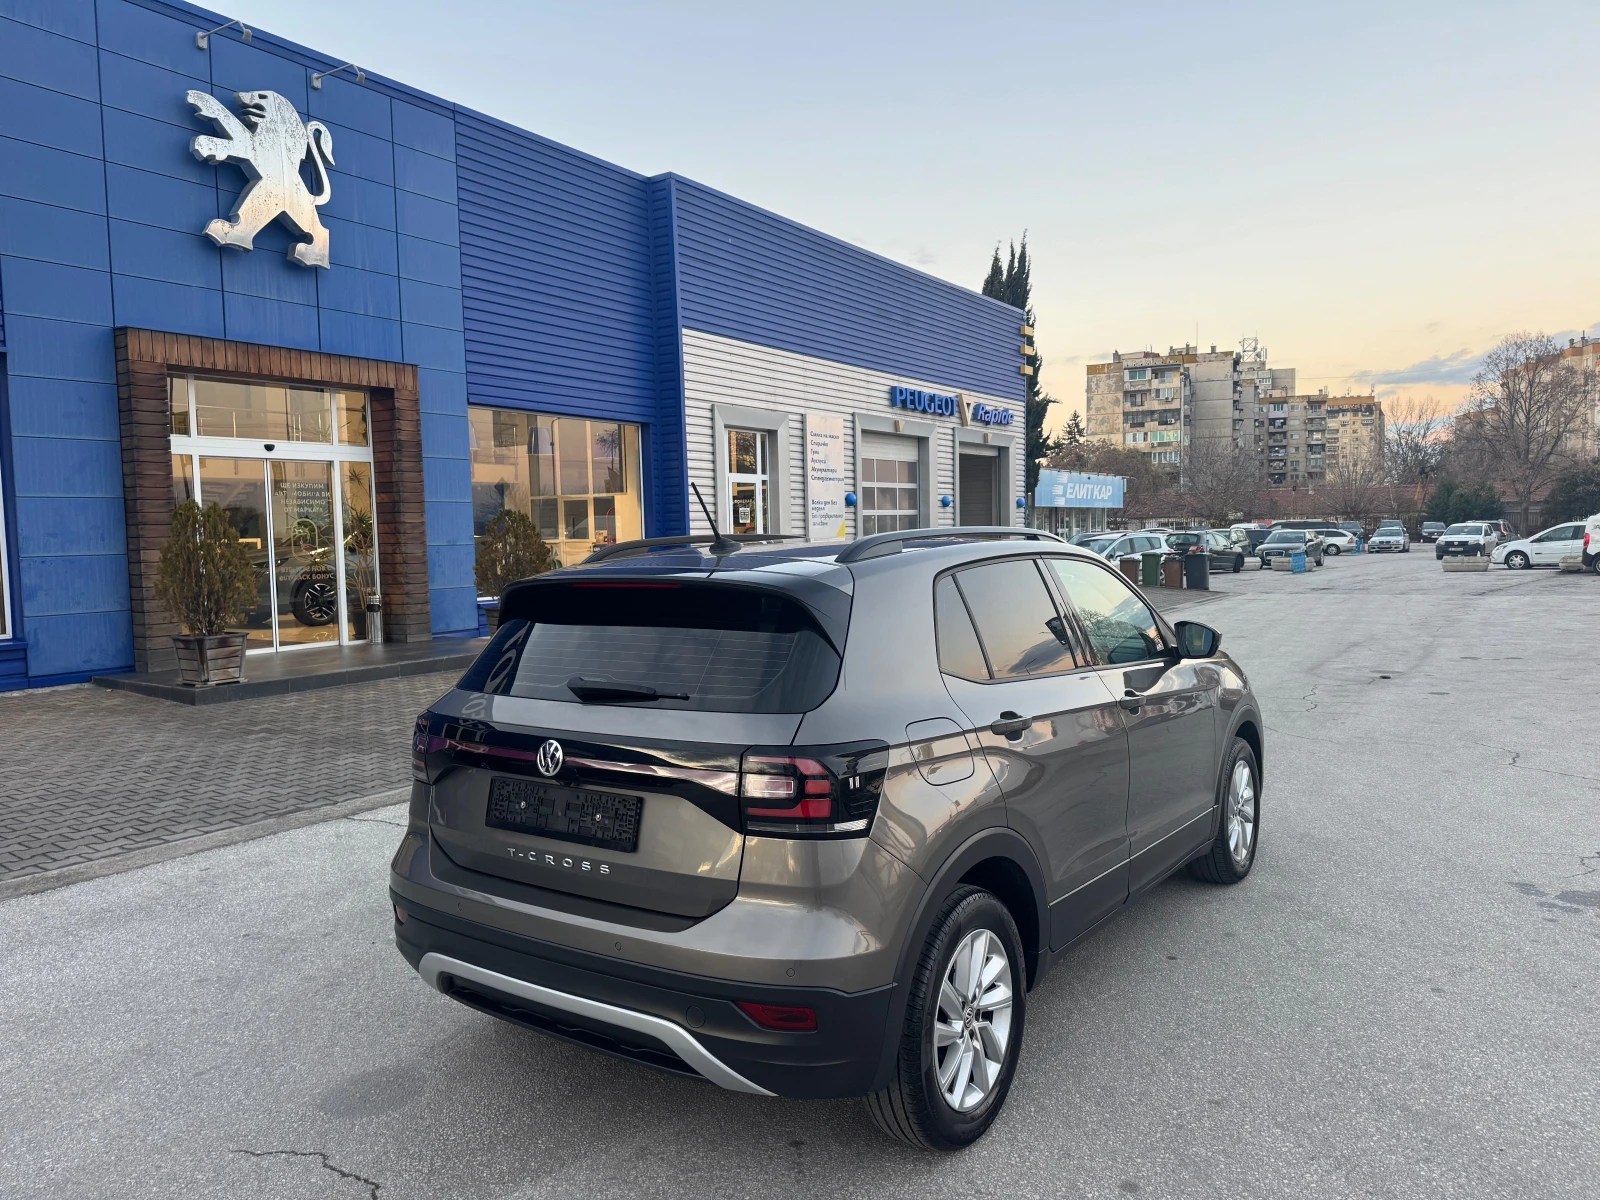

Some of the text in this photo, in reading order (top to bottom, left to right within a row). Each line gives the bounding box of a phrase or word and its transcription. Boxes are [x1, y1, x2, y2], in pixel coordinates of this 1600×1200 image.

[892, 386, 1015, 425] PEUGEOT Rapide
[507, 847, 610, 875] T-CROSS
